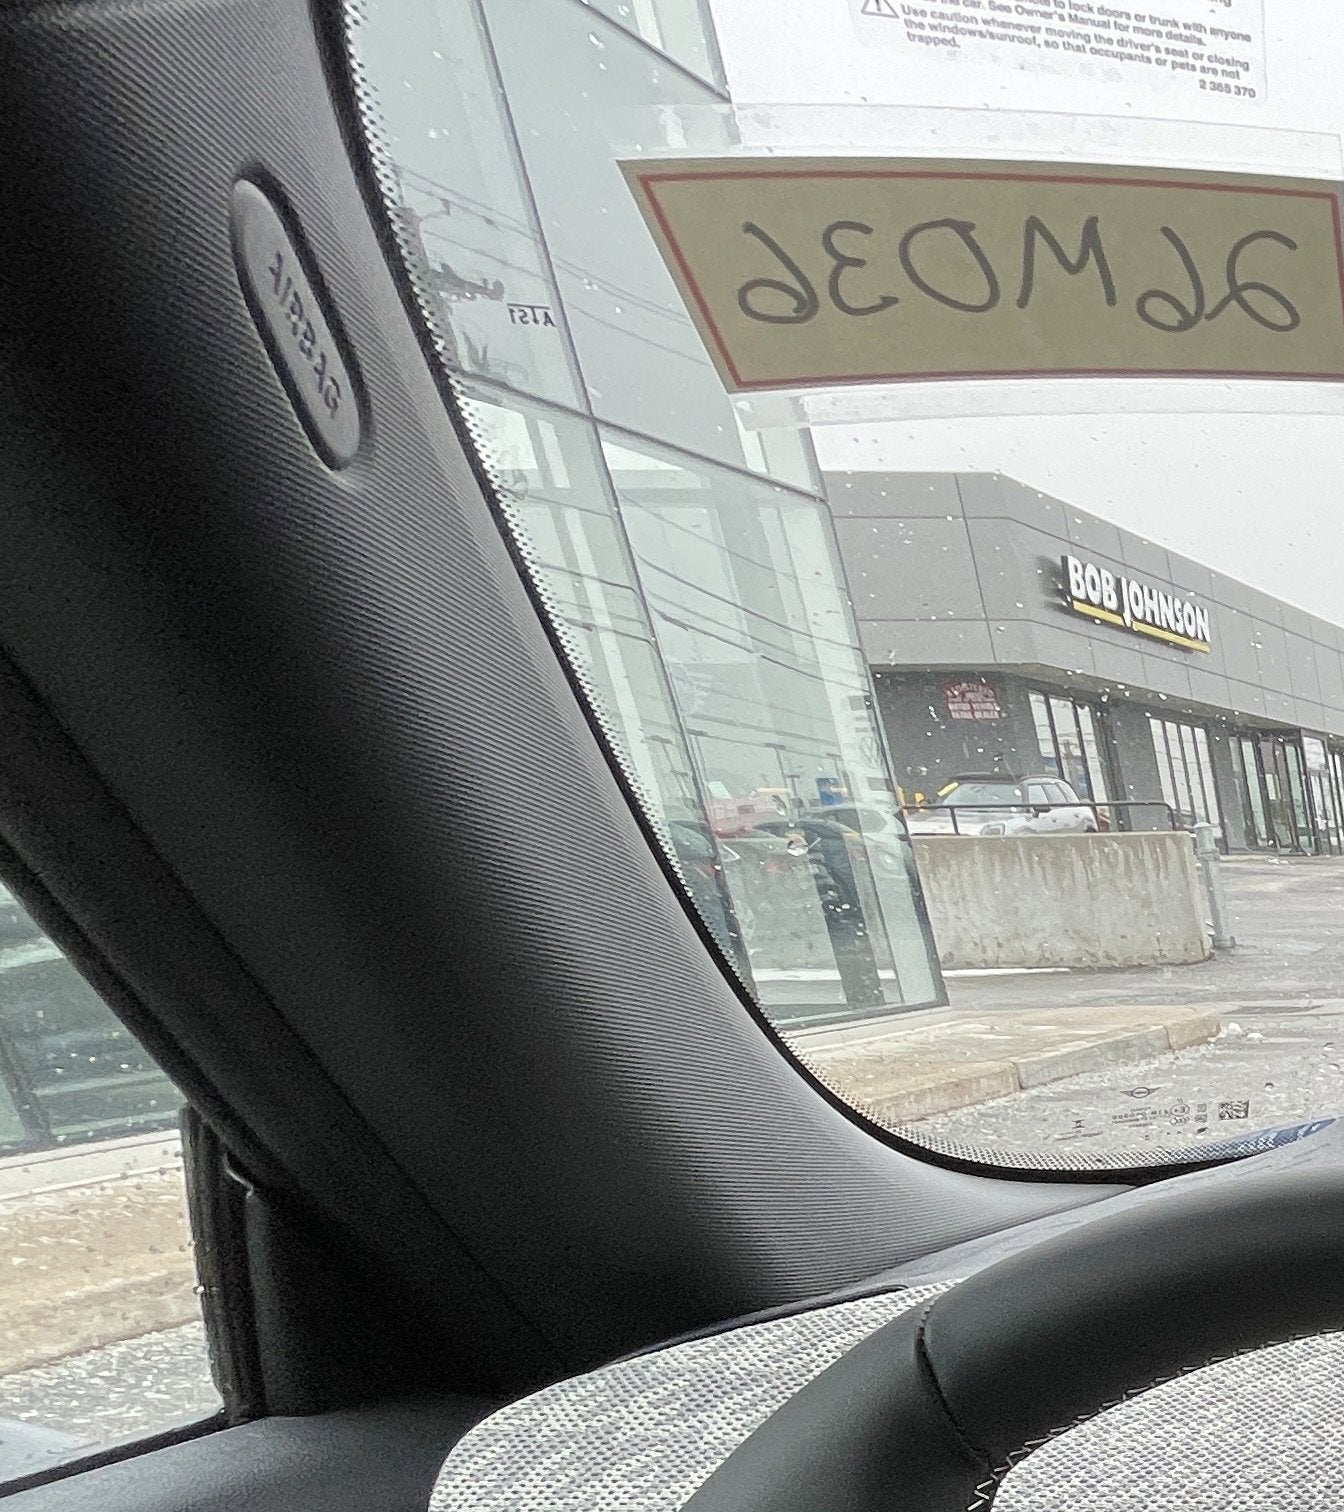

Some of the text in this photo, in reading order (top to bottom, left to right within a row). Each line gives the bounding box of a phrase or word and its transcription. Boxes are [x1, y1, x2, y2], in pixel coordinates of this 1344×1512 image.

[901, 3, 1251, 72] Use caution whenever moving the driver's seat or closing
[906, 30, 961, 48] trapped.
[988, 0, 1013, 14] See
[1014, 4, 1066, 22] Owner's
[1068, 13, 1111, 30] Manual
[1113, 20, 1130, 32] for
[1132, 26, 1163, 39] more
[1165, 31, 1207, 47] details.
[1054, 0, 1066, 9] to
[1068, 0, 1095, 14] lock
[1097, 5, 1131, 20] doors
[1134, 12, 1146, 22] or
[1149, 14, 1180, 29] trunk
[1182, 22, 1207, 34] with
[1209, 26, 1252, 43] anyone
[903, 18, 926, 30] the
[1044, 39, 1059, 49] so
[1062, 41, 1086, 54] that
[1089, 46, 1152, 64] occupants
[1155, 56, 1168, 67] or
[1171, 60, 1197, 72] pets
[1200, 65, 1219, 77] are
[1221, 68, 1241, 80] not
[1198, 79, 1257, 98] 2 365 370
[1067, 554, 1212, 643] BOB JOHNSON
